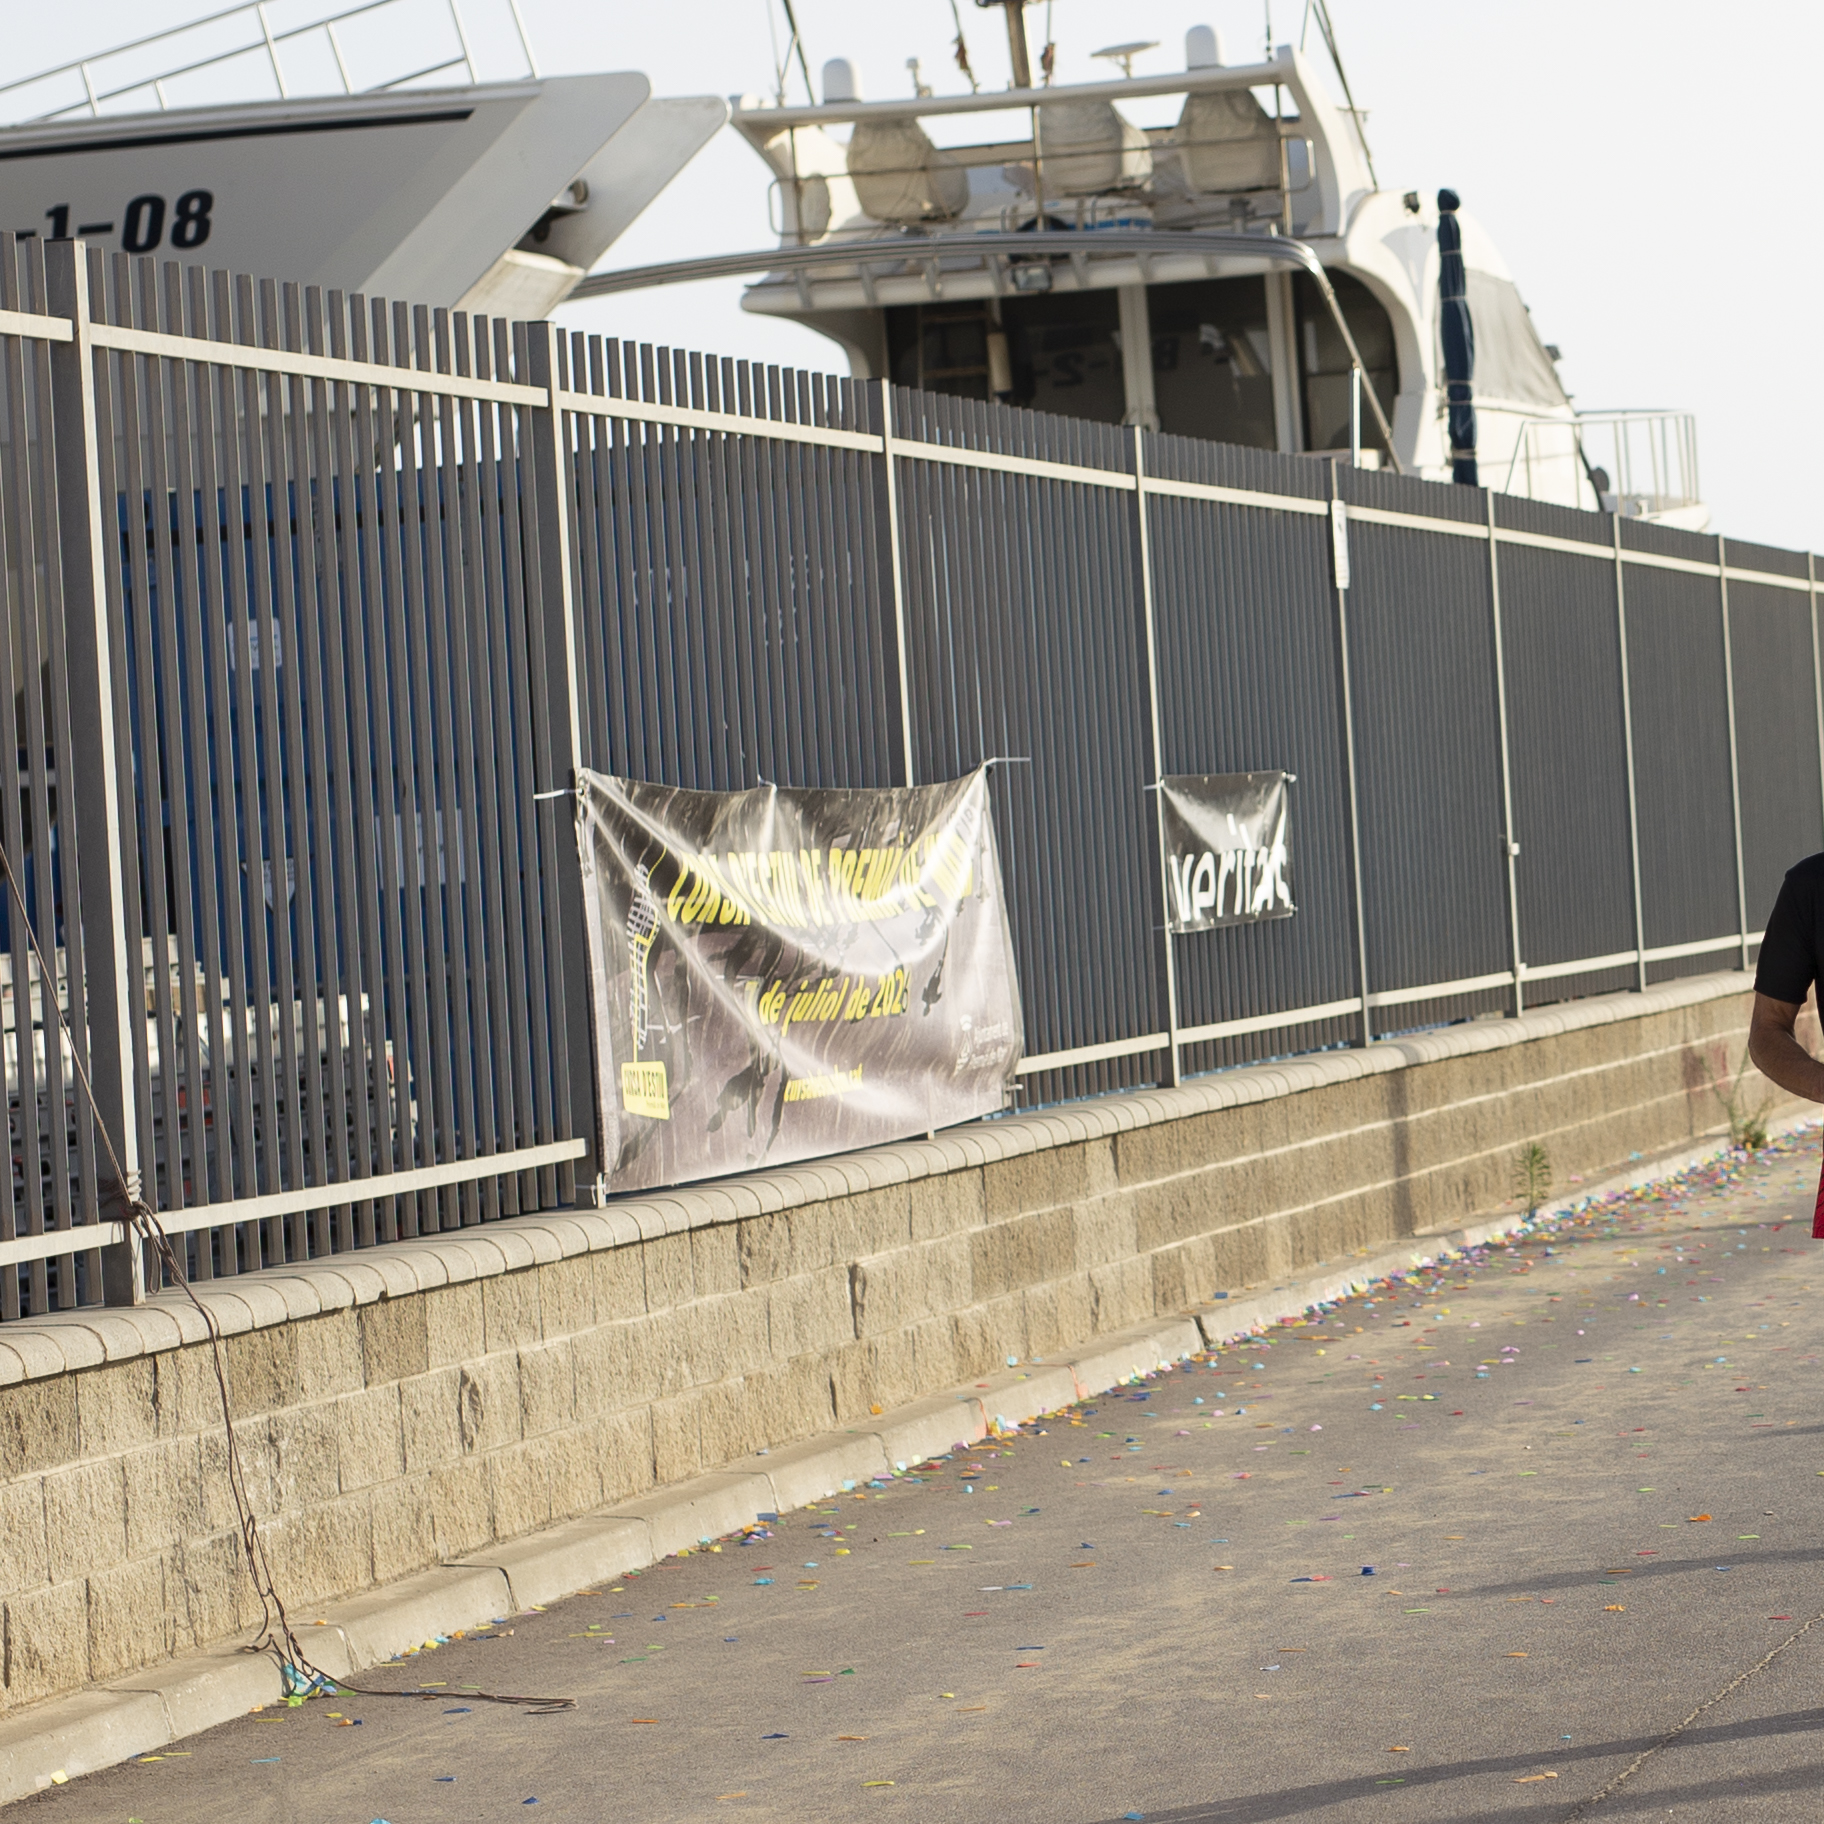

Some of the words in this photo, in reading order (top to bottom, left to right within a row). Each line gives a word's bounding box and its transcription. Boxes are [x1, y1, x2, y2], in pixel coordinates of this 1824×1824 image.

[758, 979, 787, 1025] de
[781, 976, 850, 1038] juliol
[844, 974, 871, 1020] de
